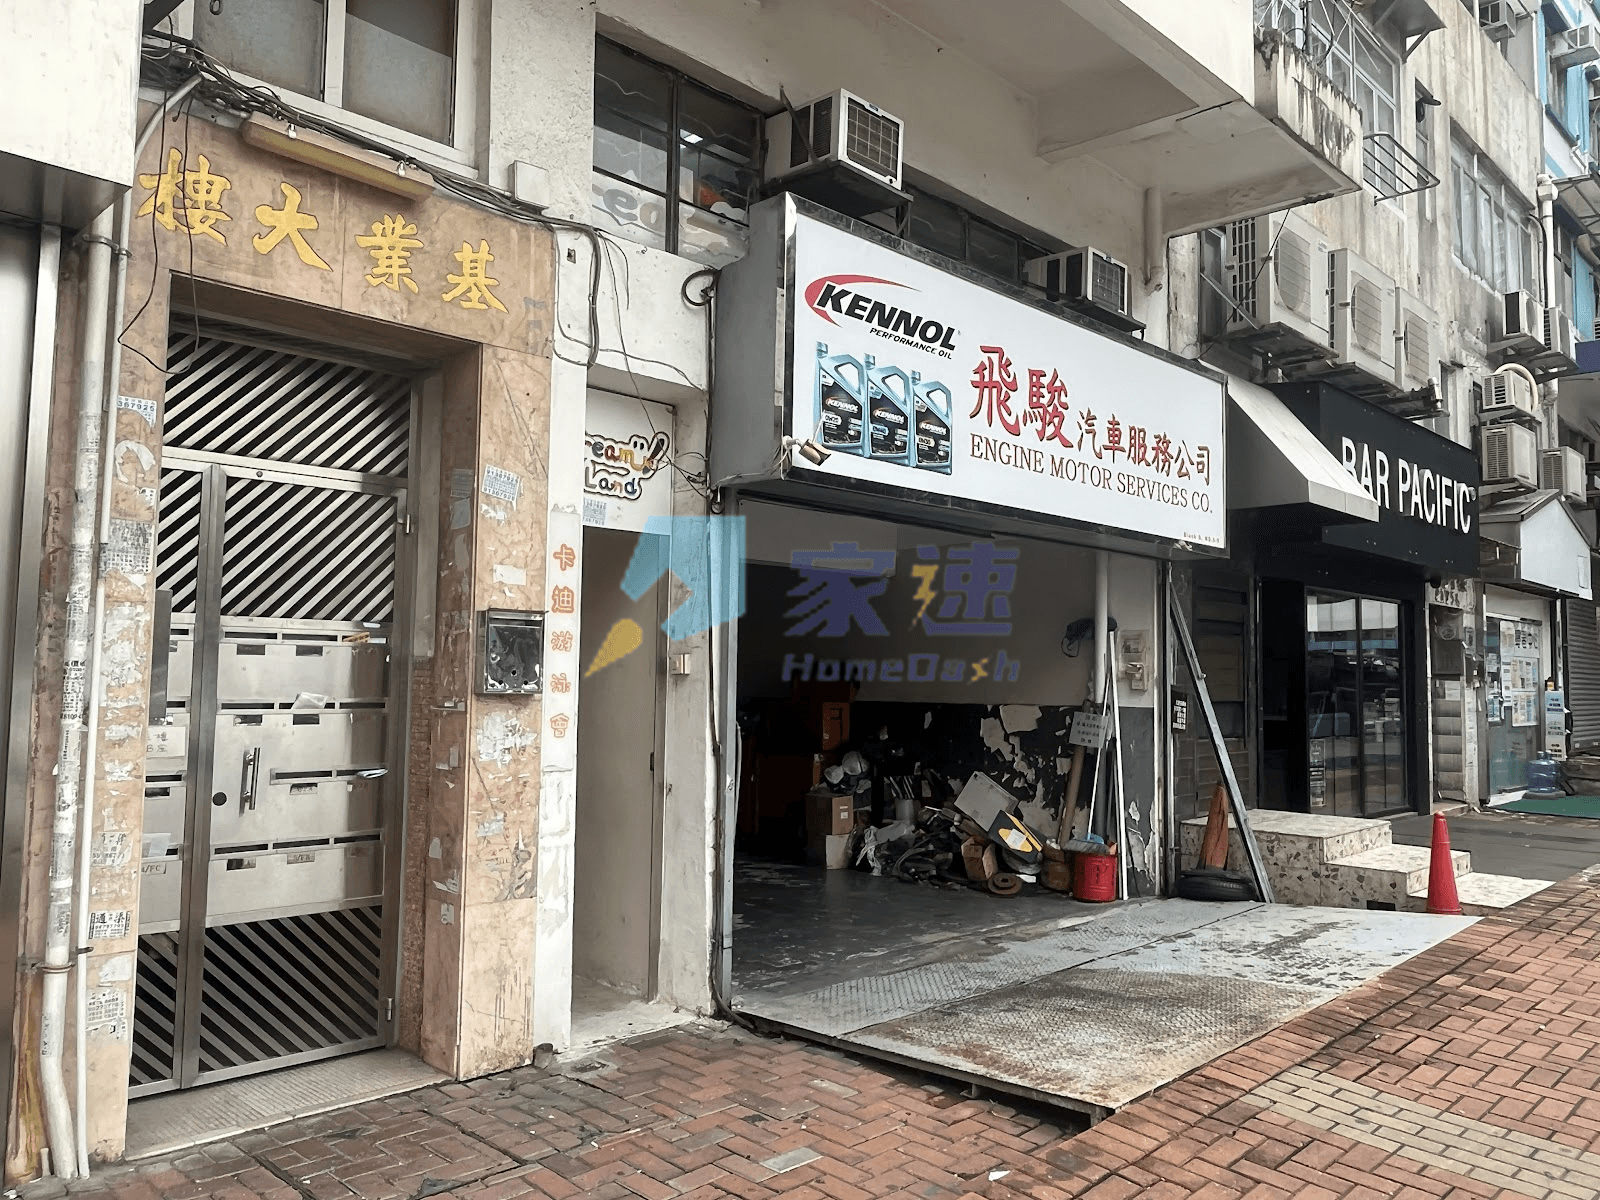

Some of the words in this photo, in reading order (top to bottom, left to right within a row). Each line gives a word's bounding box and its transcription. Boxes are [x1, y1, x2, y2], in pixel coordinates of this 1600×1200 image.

[816, 283, 956, 351] KENNOL
[869, 327, 936, 354] PERFORMANCE
[938, 350, 952, 360] OIL
[969, 345, 1074, 449] 飛駿
[1077, 407, 1211, 486] 汽車服務公司
[584, 466, 638, 495] Land
[970, 433, 1044, 474] ENGINE
[1050, 455, 1112, 490] MOTOR
[1117, 473, 1188, 509] SERVICES
[1192, 485, 1213, 514] CO.
[1342, 436, 1390, 510] BAR
[1398, 458, 1471, 534] PACIFIC
